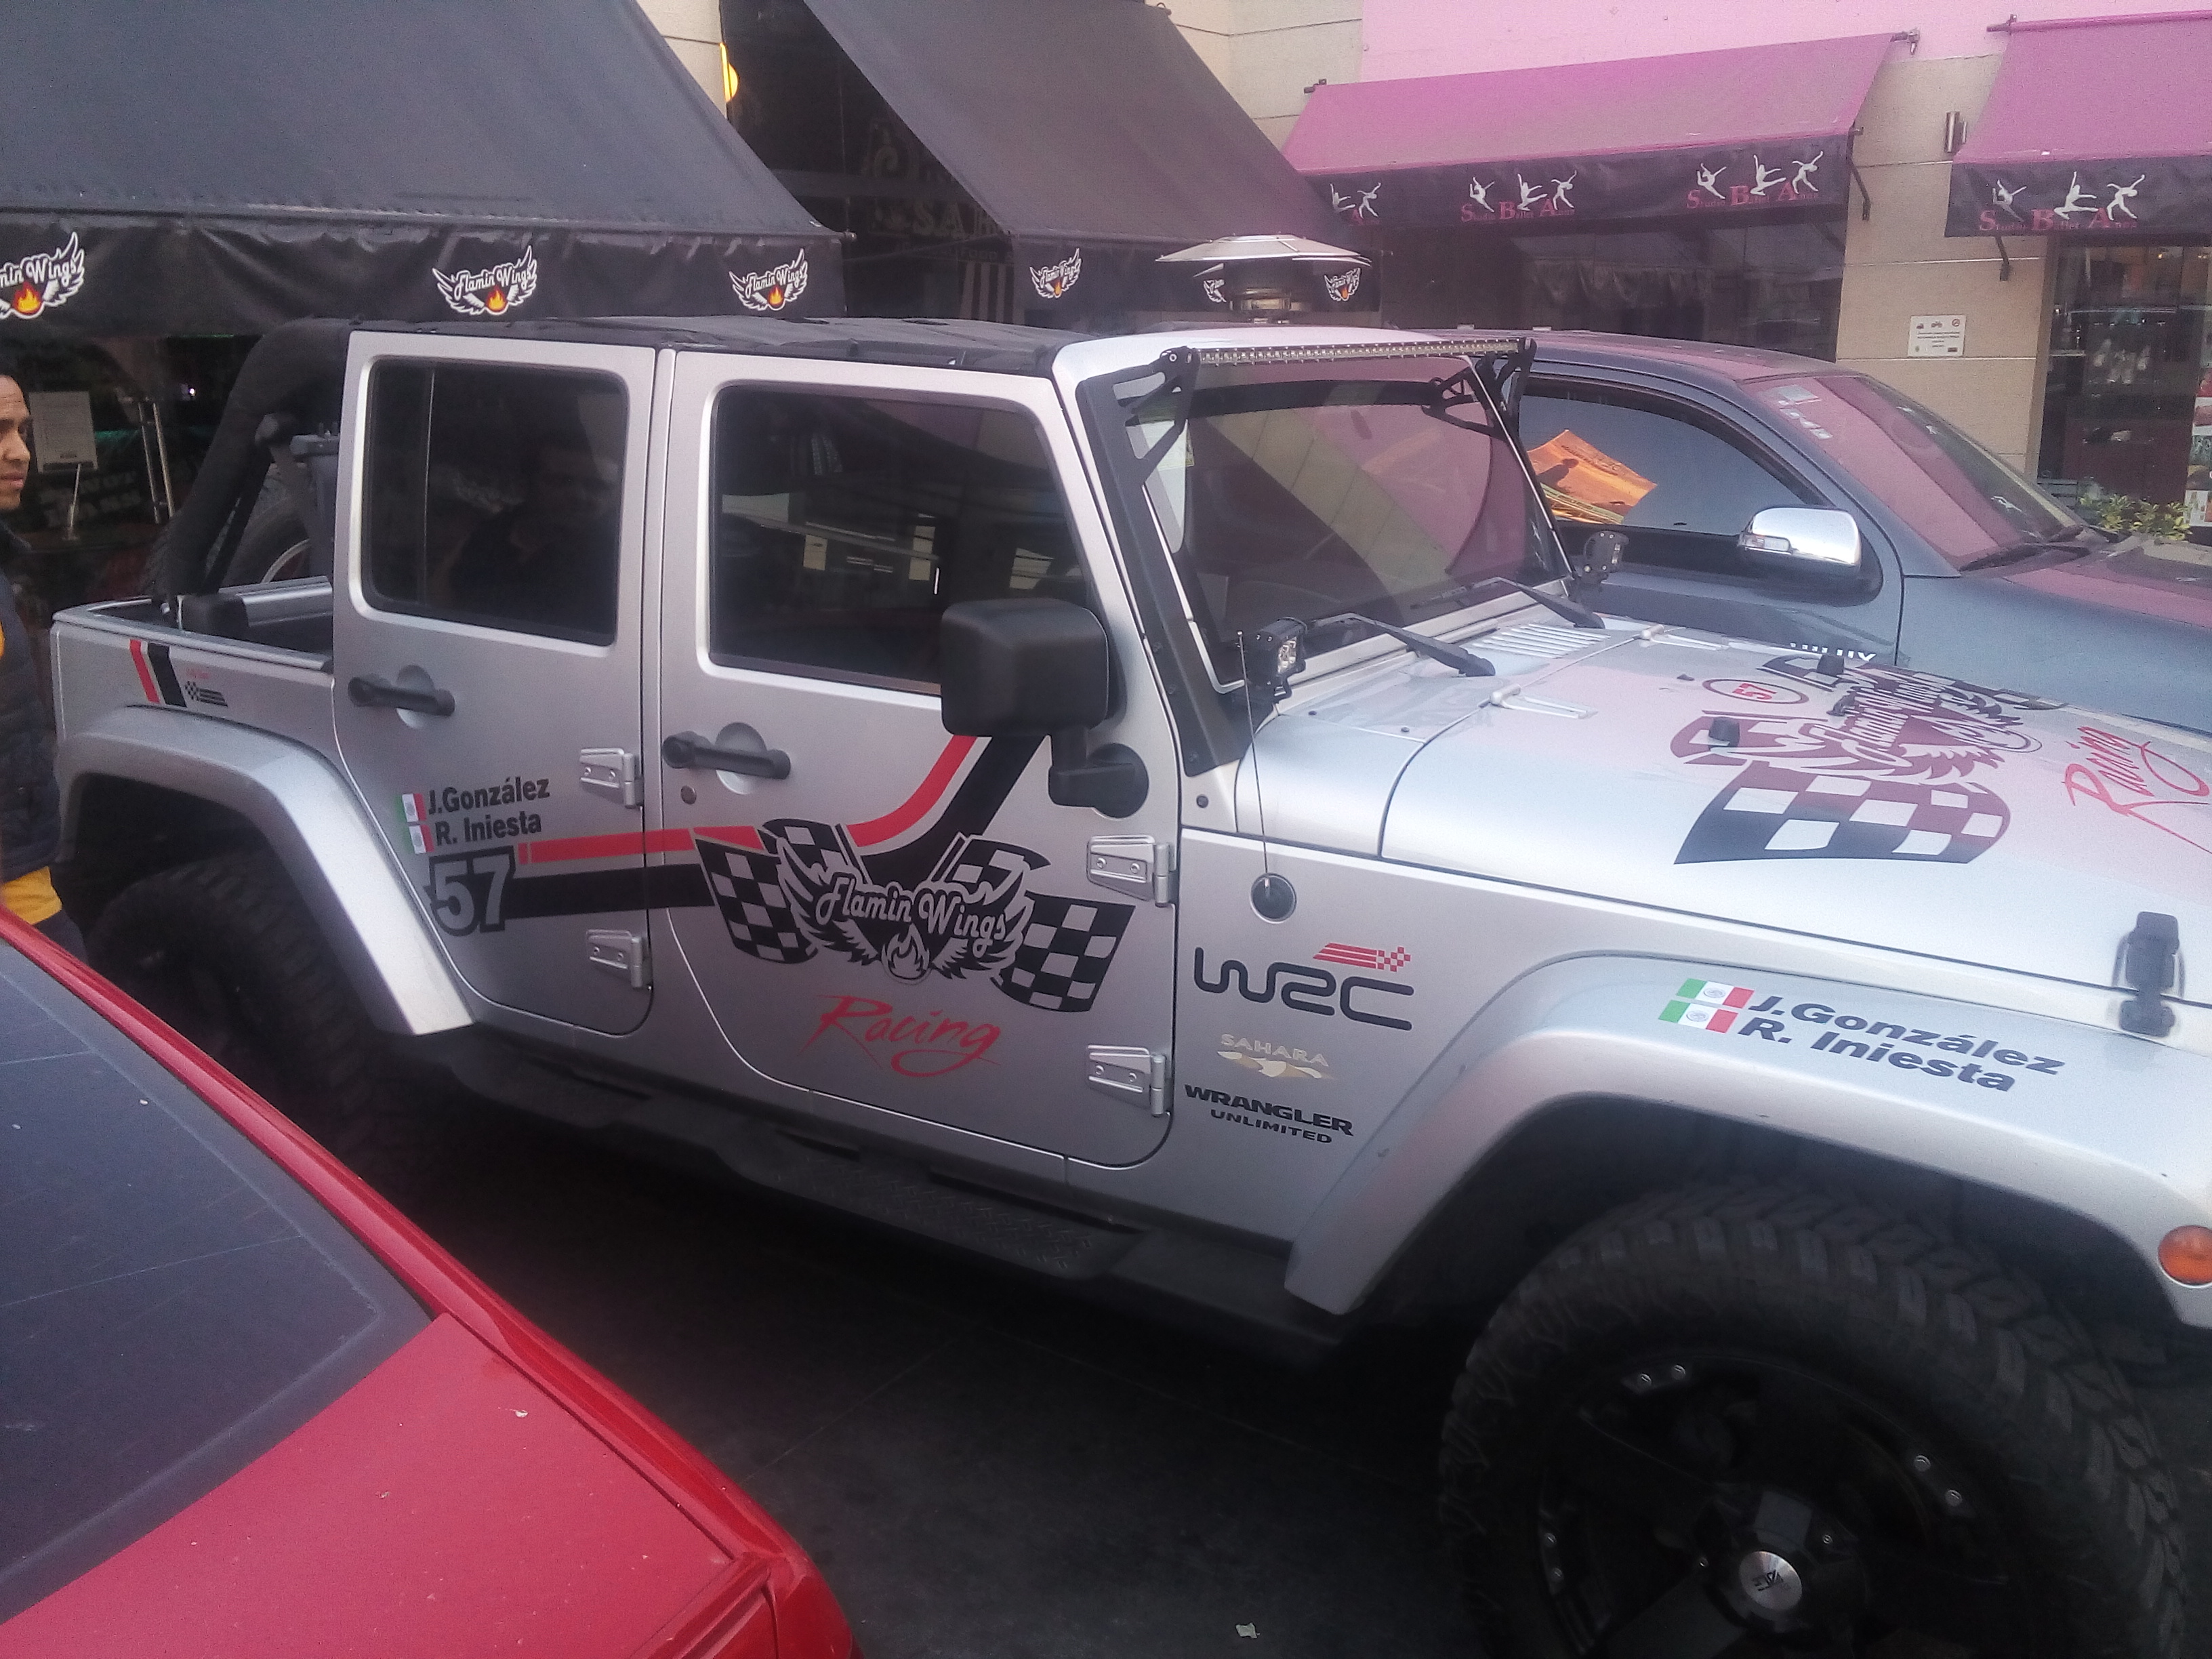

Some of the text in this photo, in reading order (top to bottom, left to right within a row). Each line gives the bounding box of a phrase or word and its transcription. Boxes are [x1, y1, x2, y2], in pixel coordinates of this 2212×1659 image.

[26, 258, 77, 287] Wings
[454, 266, 531, 301] Flamin Wings
[745, 268, 803, 299] Flamin Wings
[1732, 682, 1778, 701] 57
[436, 811, 542, 846] R. Iniesta
[429, 846, 515, 936] 57
[815, 878, 1006, 958] Flamin Wings
[1193, 947, 1414, 1031] WRC
[798, 994, 1001, 1078] Racing
[1220, 1033, 1330, 1067] SAHARA
[1738, 1017, 2015, 1092] R. Iniesta
[1185, 1084, 1354, 1136] WRANGLER
[1210, 1109, 1332, 1143] UNLIMITED
